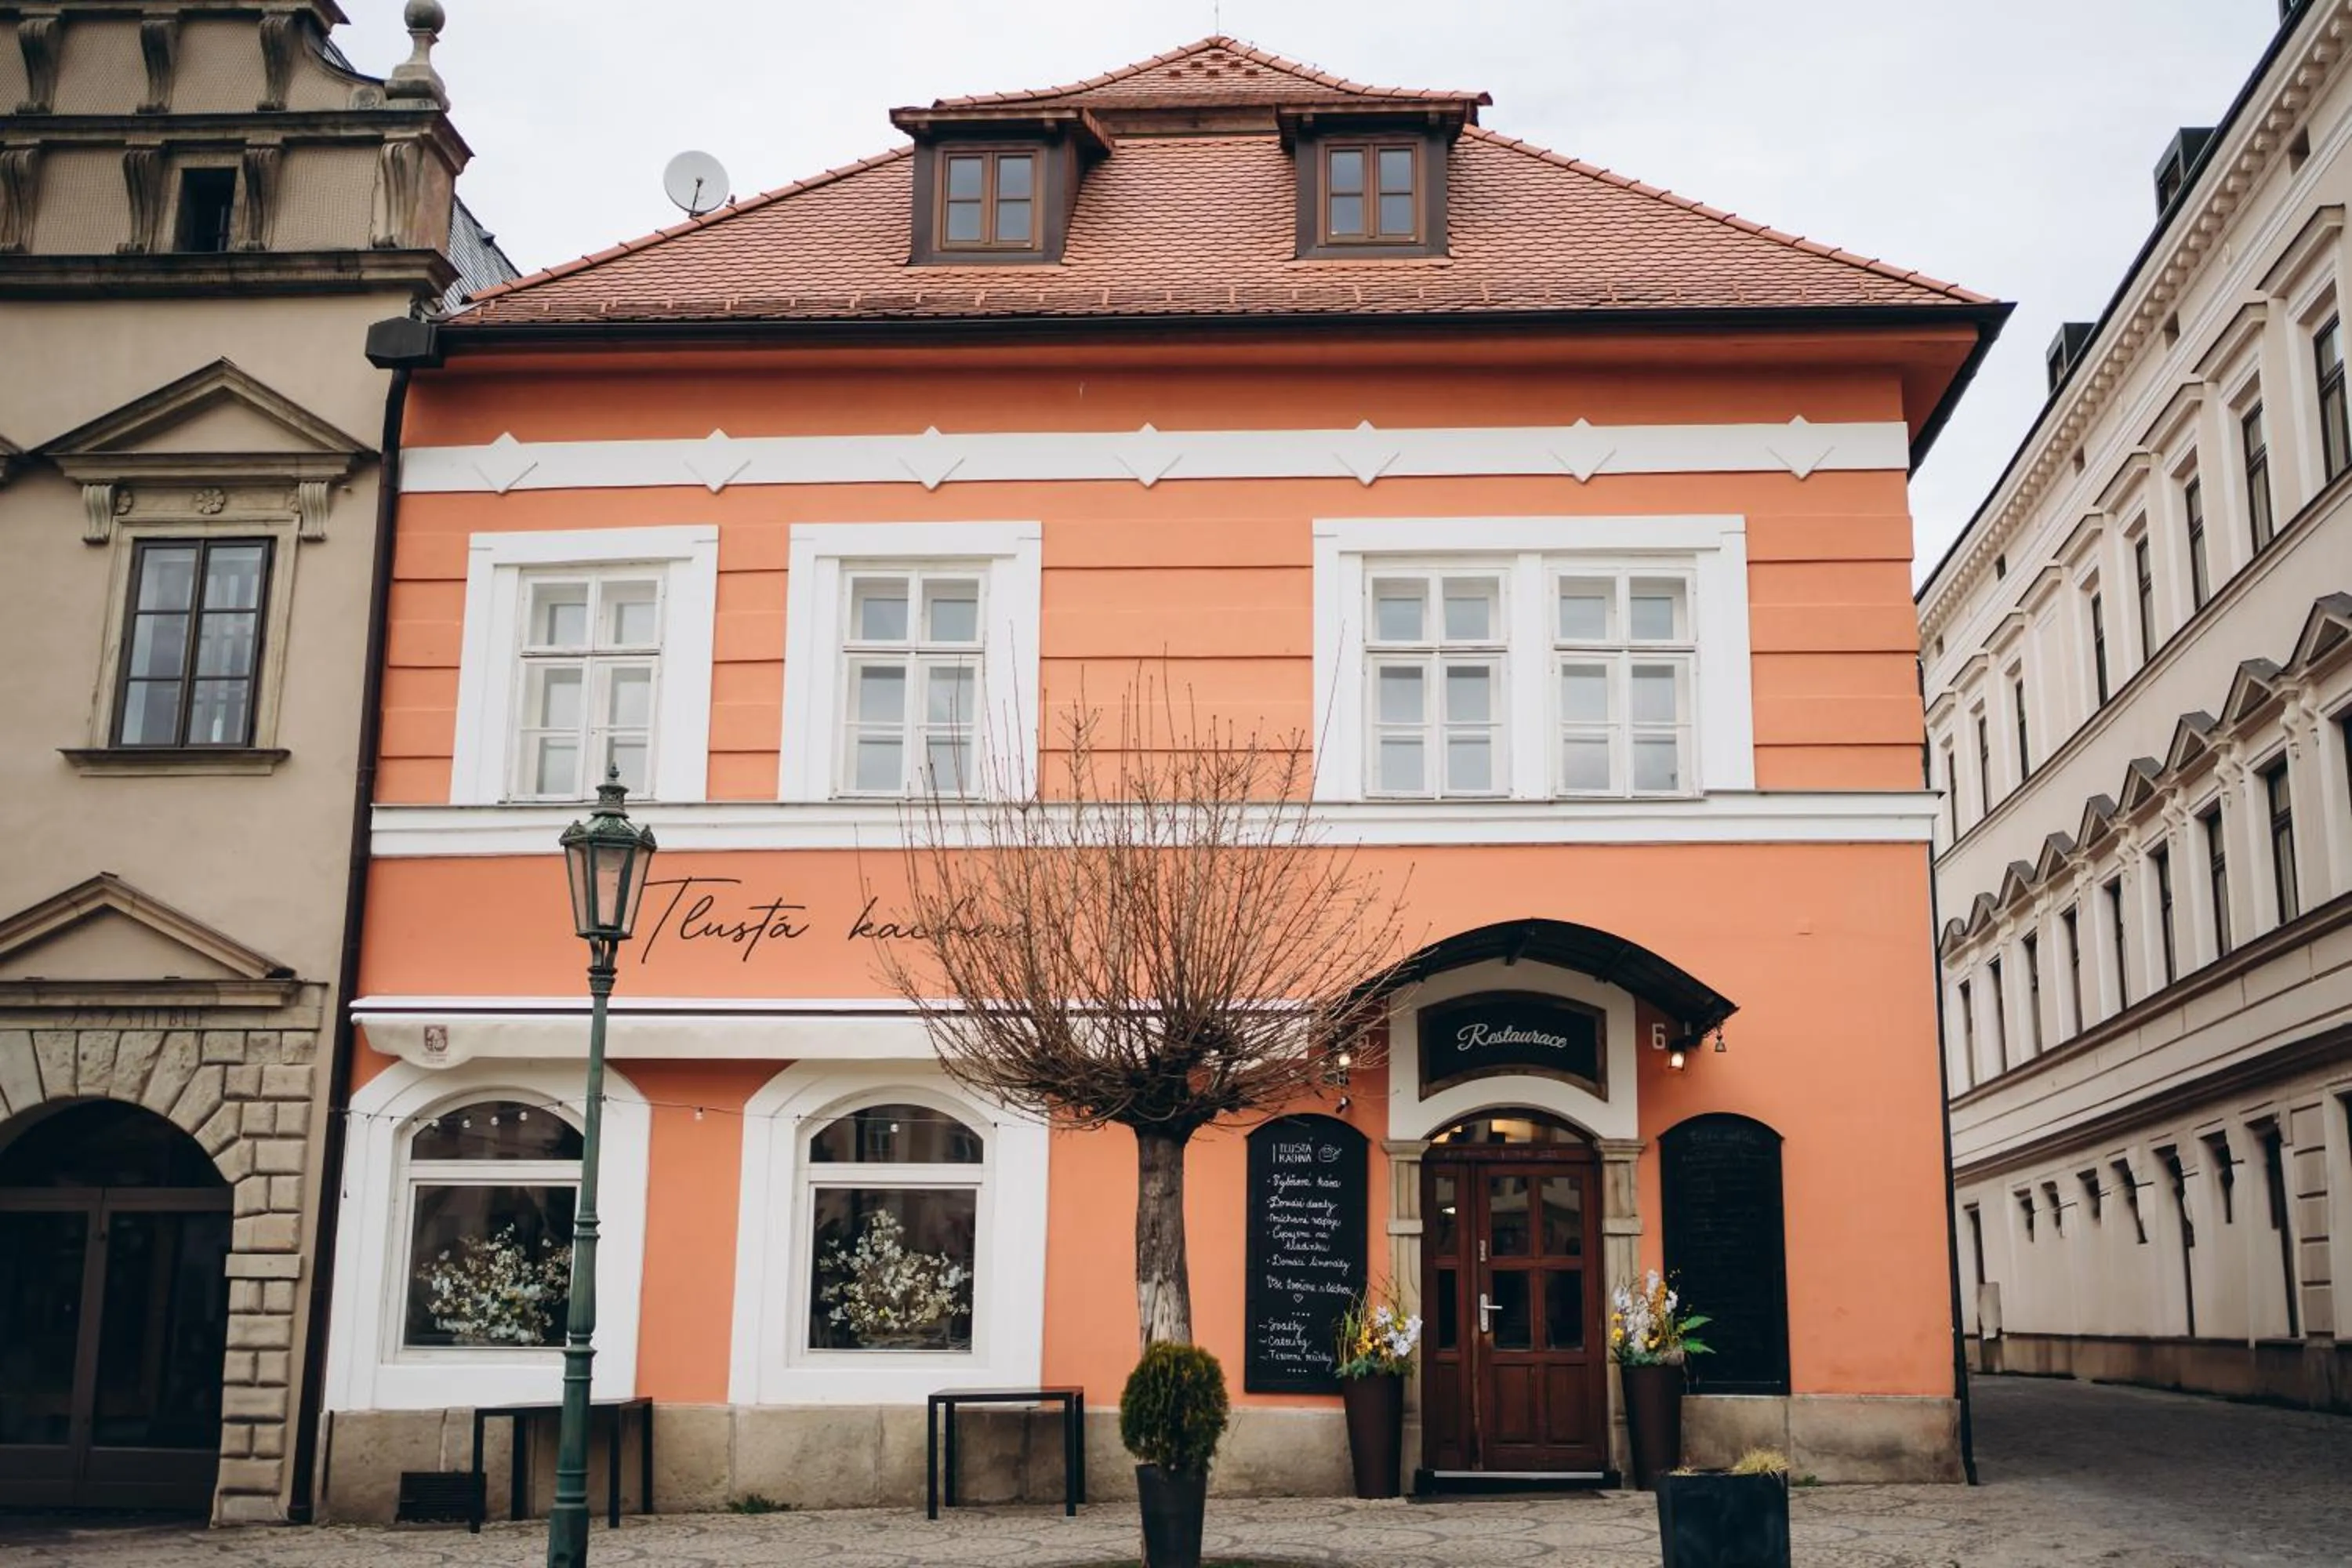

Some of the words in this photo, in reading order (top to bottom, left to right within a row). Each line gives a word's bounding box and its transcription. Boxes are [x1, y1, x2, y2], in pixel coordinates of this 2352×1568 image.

[641, 877, 810, 964] Tlustá
[1456, 1022, 1568, 1051] Restaurace
[1651, 1022, 1666, 1050] 6
